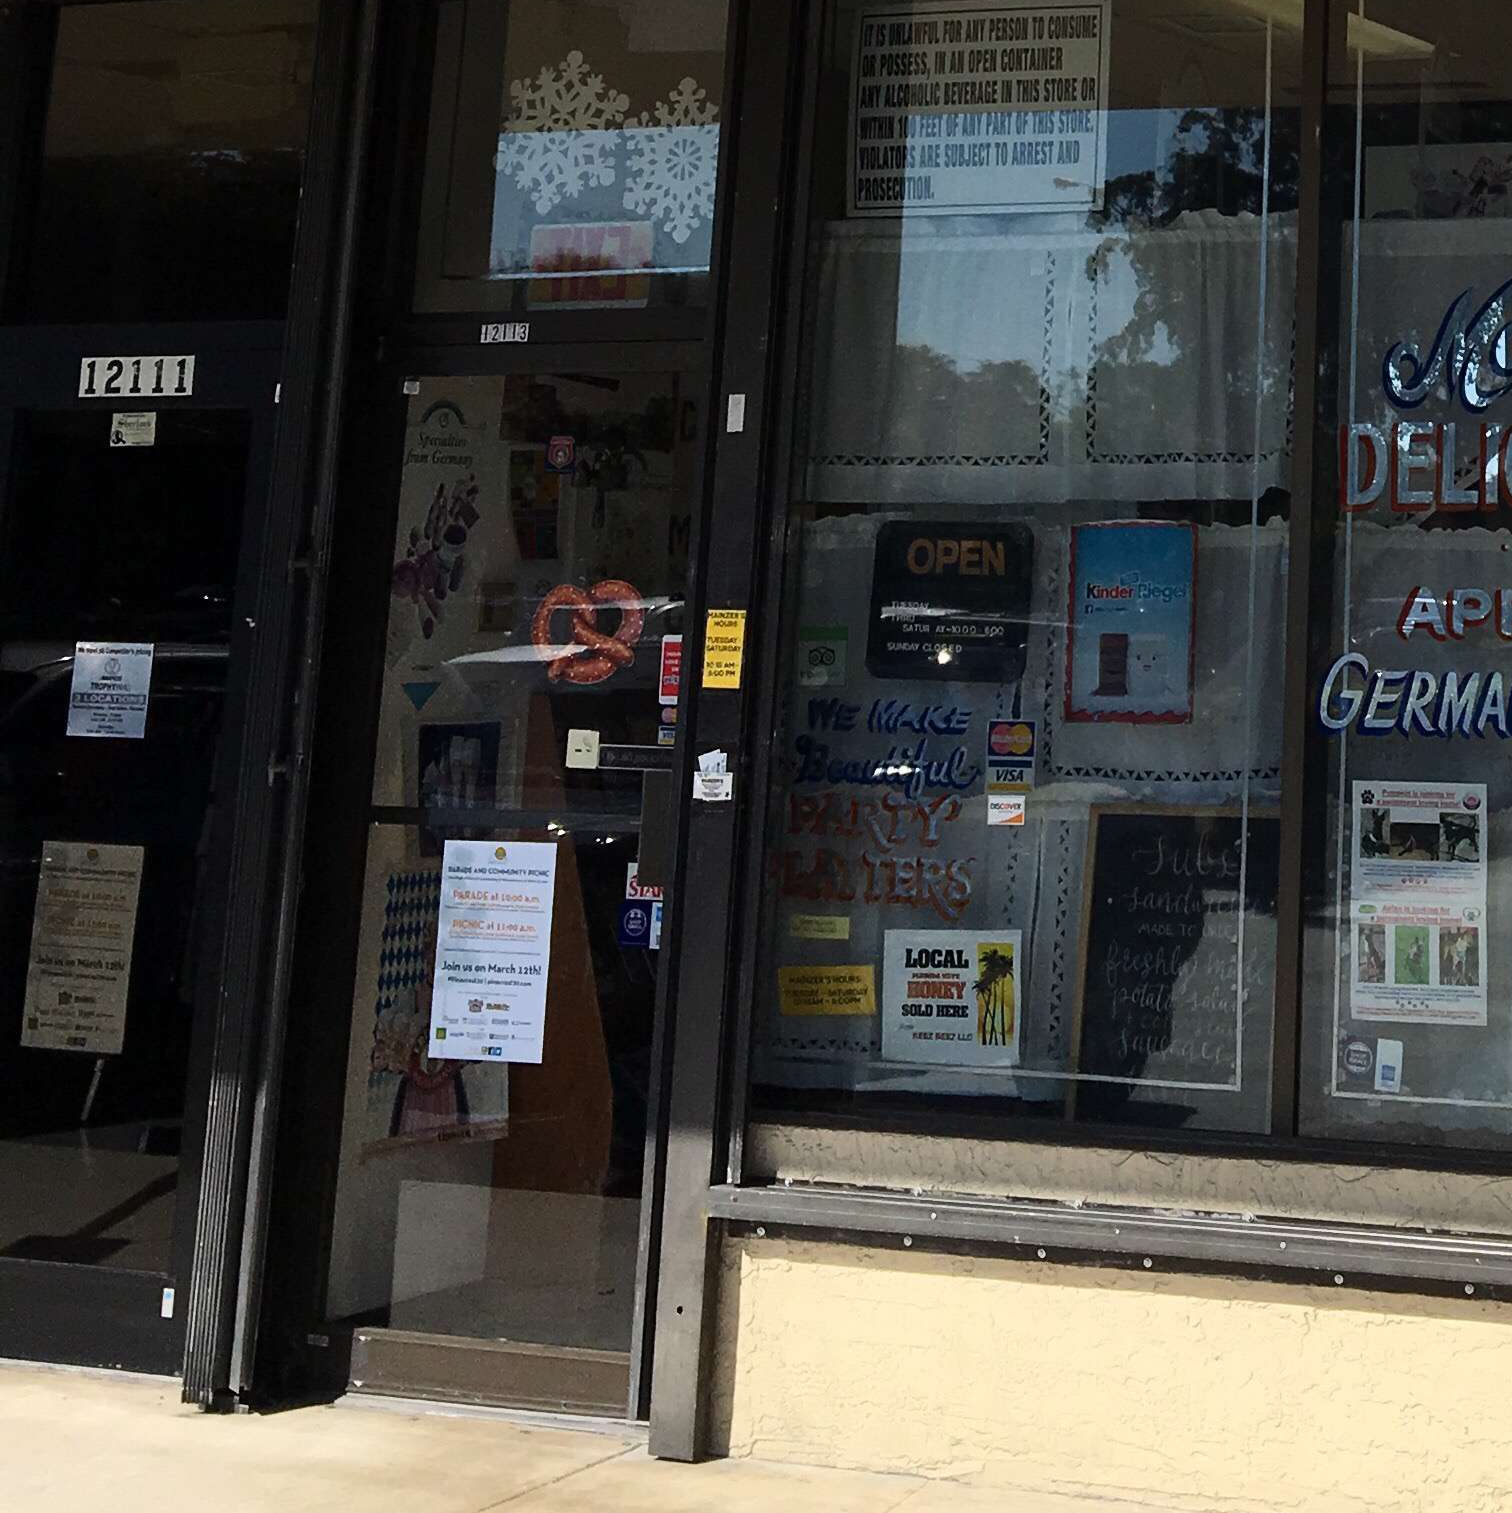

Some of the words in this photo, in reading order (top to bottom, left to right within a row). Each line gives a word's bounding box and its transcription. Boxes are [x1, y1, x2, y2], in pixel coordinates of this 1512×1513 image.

[889, 21, 940, 45] UNLAWFUL
[943, 19, 961, 43] FOR
[965, 19, 986, 43] ANY
[989, 17, 1028, 42] PERSON
[1032, 16, 1044, 40] TO
[1048, 15, 1097, 39] CONSUME
[862, 54, 876, 77] OR
[880, 51, 930, 80] POSSESS,
[935, 51, 946, 75] IN
[949, 50, 964, 74] AN
[968, 49, 997, 73] OPEN
[1001, 47, 1063, 72] CONTAINER
[861, 85, 880, 108] ANY
[884, 82, 940, 107] ALCOHOLIC
[943, 79, 998, 105] BEVERAGE
[1001, 79, 1012, 103] IN
[1016, 78, 1040, 103] THIS
[1044, 78, 1077, 102] STORE
[1081, 77, 1096, 101] OR
[860, 116, 894, 139] WITHIN
[920, 114, 943, 137] FEET
[946, 113, 958, 137] OF
[962, 113, 982, 136] ANY
[986, 112, 1012, 136] PART
[1016, 111, 1029, 135] OF
[1033, 110, 1055, 134] THIS
[1058, 109, 1094, 134] STORE.
[859, 145, 915, 169] VIOLATORS
[919, 144, 940, 168] ARE
[944, 143, 991, 167] SUBJECT
[994, 142, 1008, 166] TO
[1011, 141, 1054, 165] ARREST
[1057, 140, 1080, 164] AND
[858, 175, 934, 201] PROSECUTION.
[484, 324, 527, 341] 12113
[84, 358, 187, 395] 12111
[906, 538, 1006, 575] OPEN
[996, 769, 1024, 782] VISA
[453, 889, 489, 901] PARADE
[452, 919, 485, 930] PICNIC
[441, 960, 461, 971] Join
[462, 963, 473, 973] us
[474, 963, 486, 972] on
[487, 963, 516, 974] March
[517, 964, 542, 976] 12th!
[905, 948, 969, 968] LOCAL
[907, 980, 967, 1000] HONEY
[901, 1004, 933, 1017] SOLD
[936, 1005, 969, 1019] HERE
